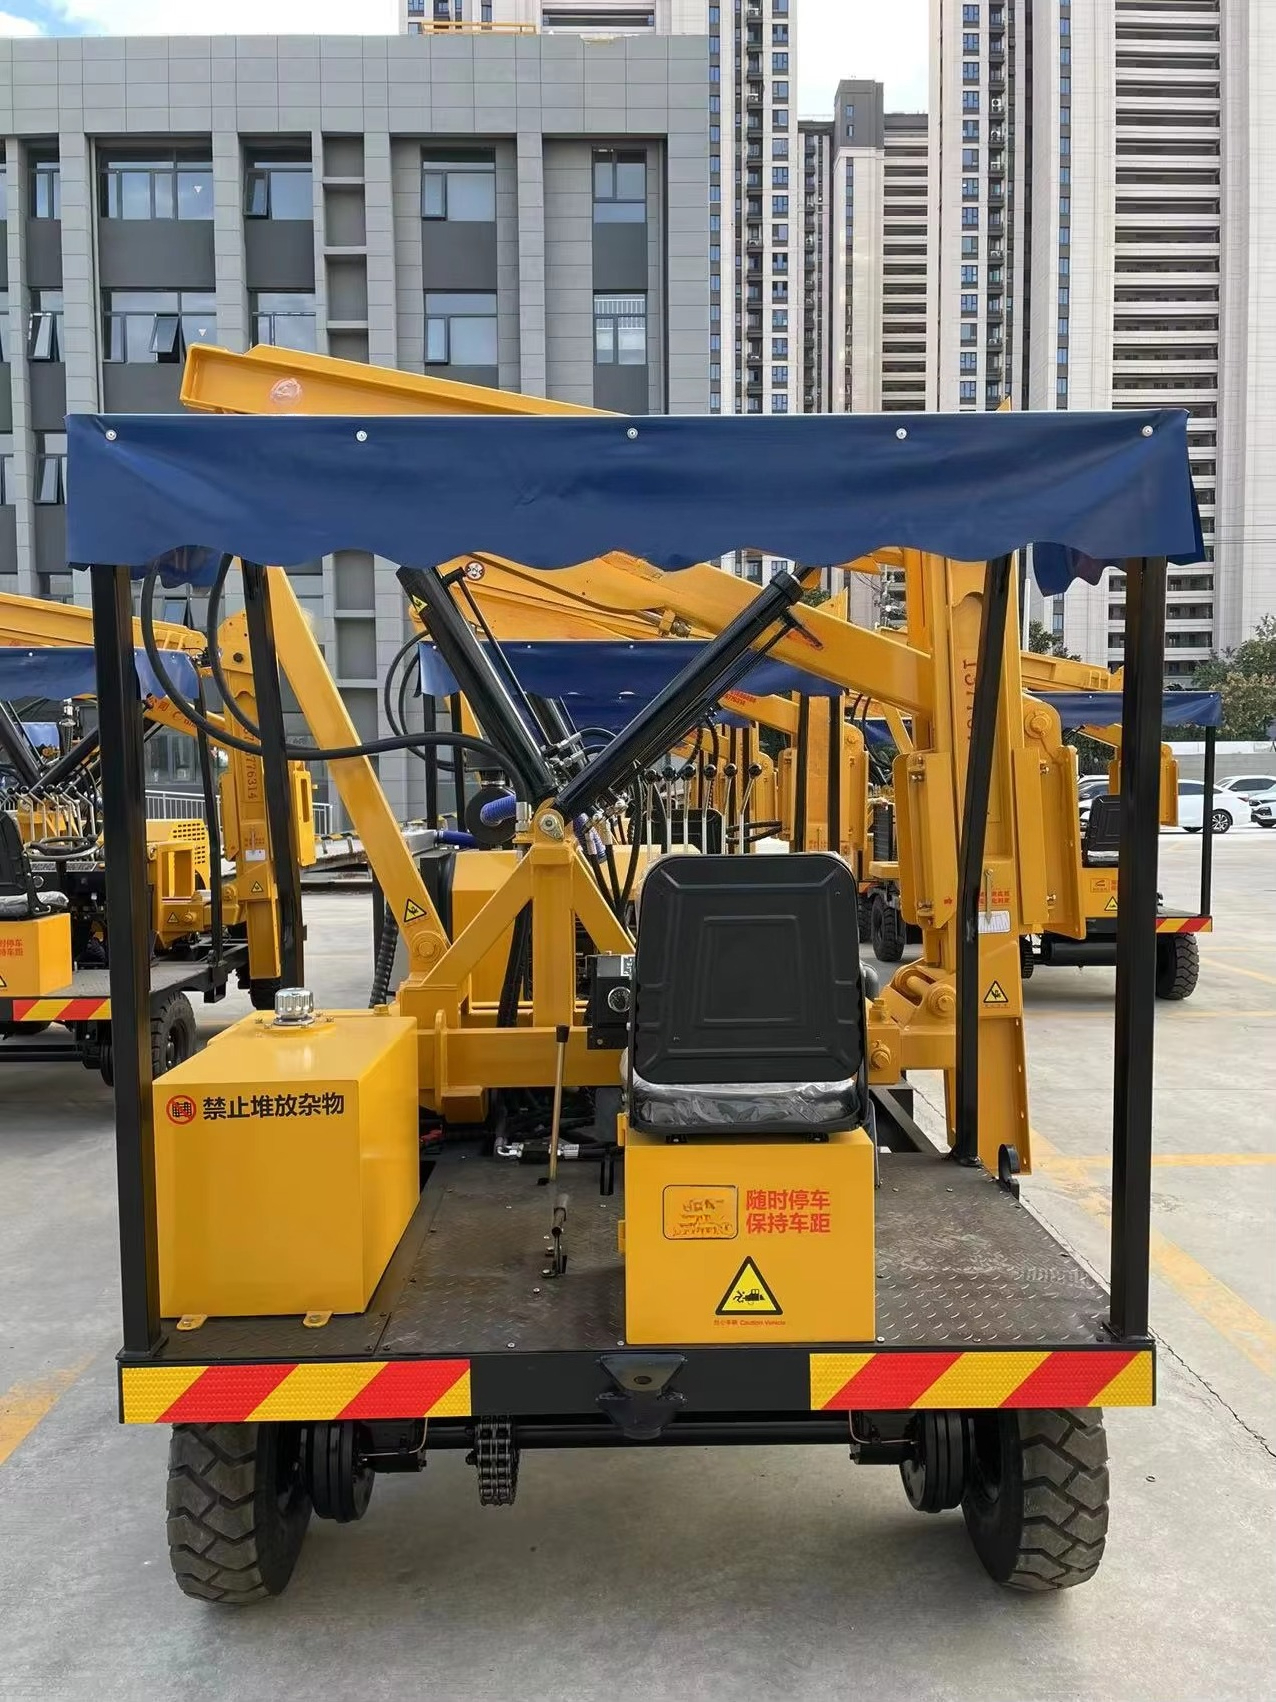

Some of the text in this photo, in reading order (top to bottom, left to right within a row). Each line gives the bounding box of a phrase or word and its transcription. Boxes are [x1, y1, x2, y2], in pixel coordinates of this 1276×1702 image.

[203, 1092, 345, 1121] 禁止堆放杂物
[746, 1189, 831, 1211] 随时停车
[746, 1212, 831, 1234] 保持车距
